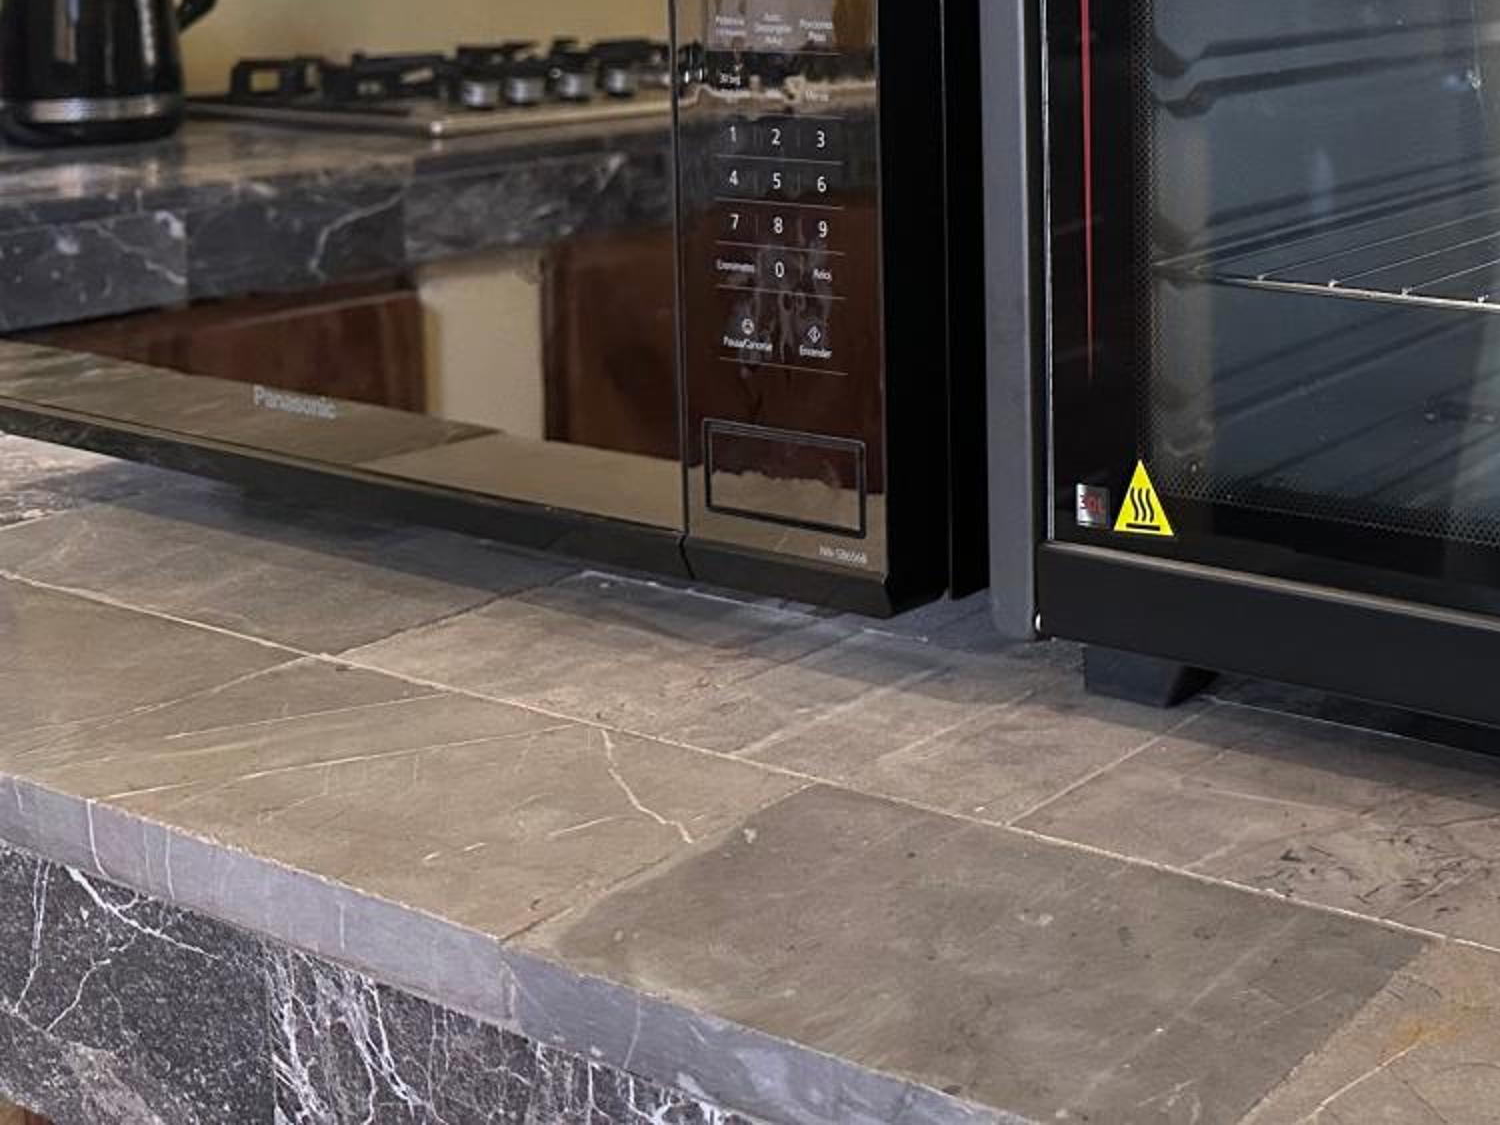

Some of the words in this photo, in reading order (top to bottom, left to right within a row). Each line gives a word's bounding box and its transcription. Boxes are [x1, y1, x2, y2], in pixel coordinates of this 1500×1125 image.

[729, 126, 737, 143] 1
[771, 128, 781, 146] 2
[816, 130, 826, 148] 3
[729, 169, 739, 186] 4
[772, 172, 782, 190] 5
[816, 176, 827, 193] 6
[730, 213, 740, 230] 7
[773, 216, 783, 235] 8
[818, 220, 829, 238] 9
[774, 261, 785, 278] 0
[253, 384, 338, 420] Panasonic
